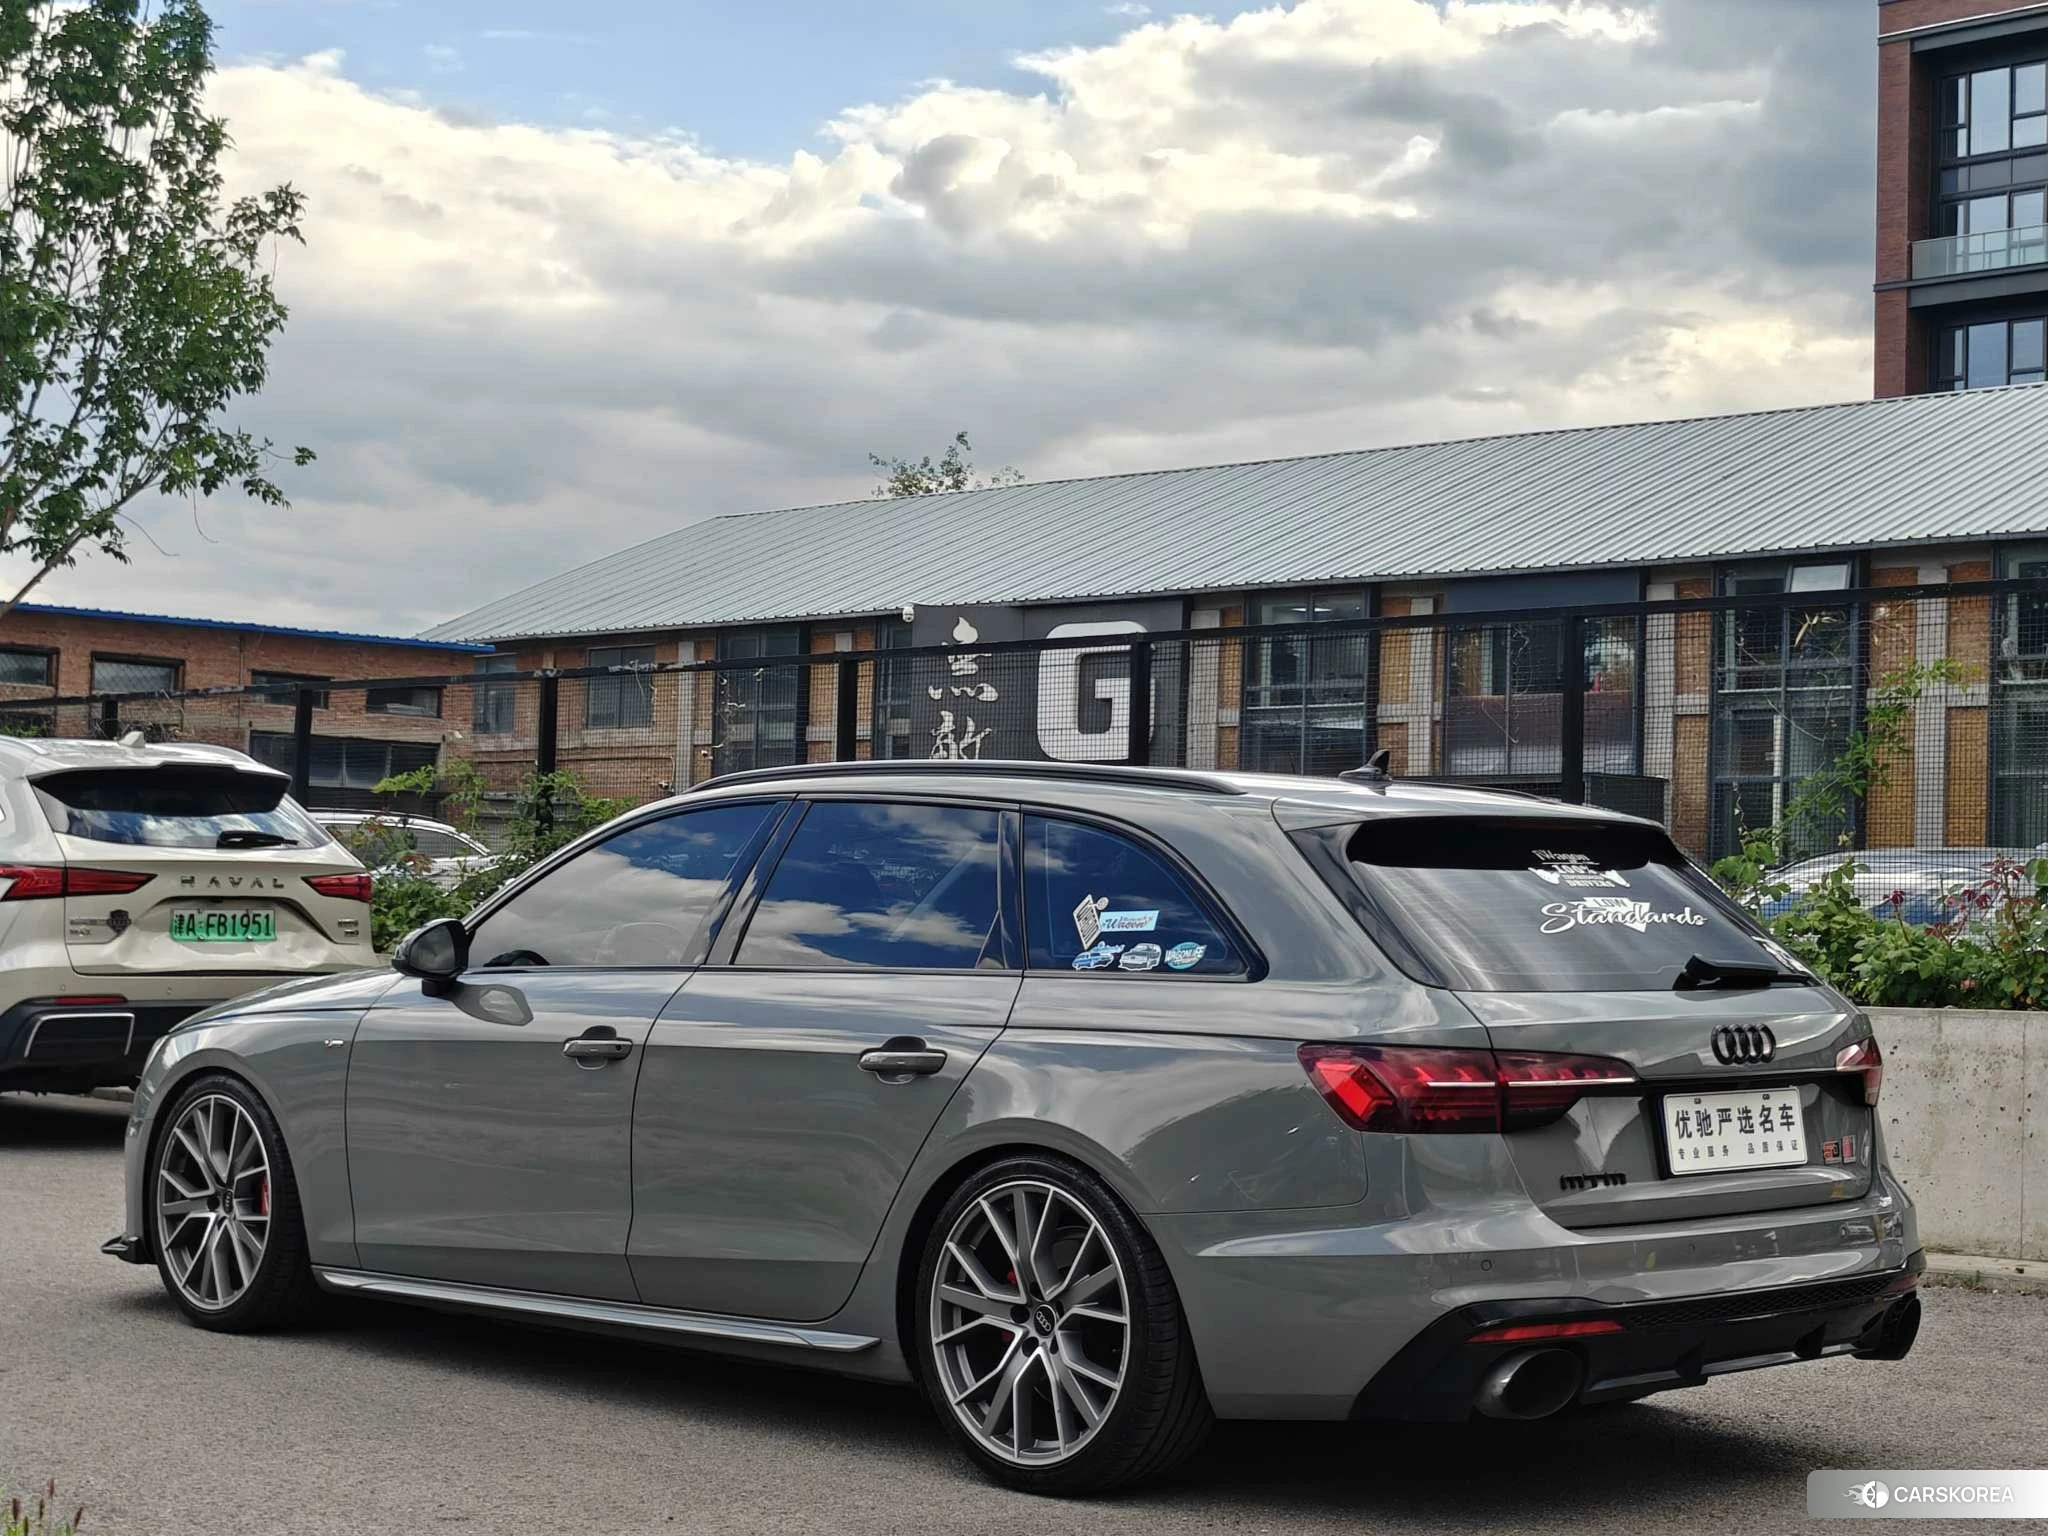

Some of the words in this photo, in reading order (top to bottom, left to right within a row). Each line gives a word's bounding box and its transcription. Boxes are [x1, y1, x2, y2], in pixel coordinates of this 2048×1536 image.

[181, 876, 284, 888] HAVAL
[1540, 902, 1707, 934] Standards
[1675, 1103, 1795, 1139] 优驰严选名车
